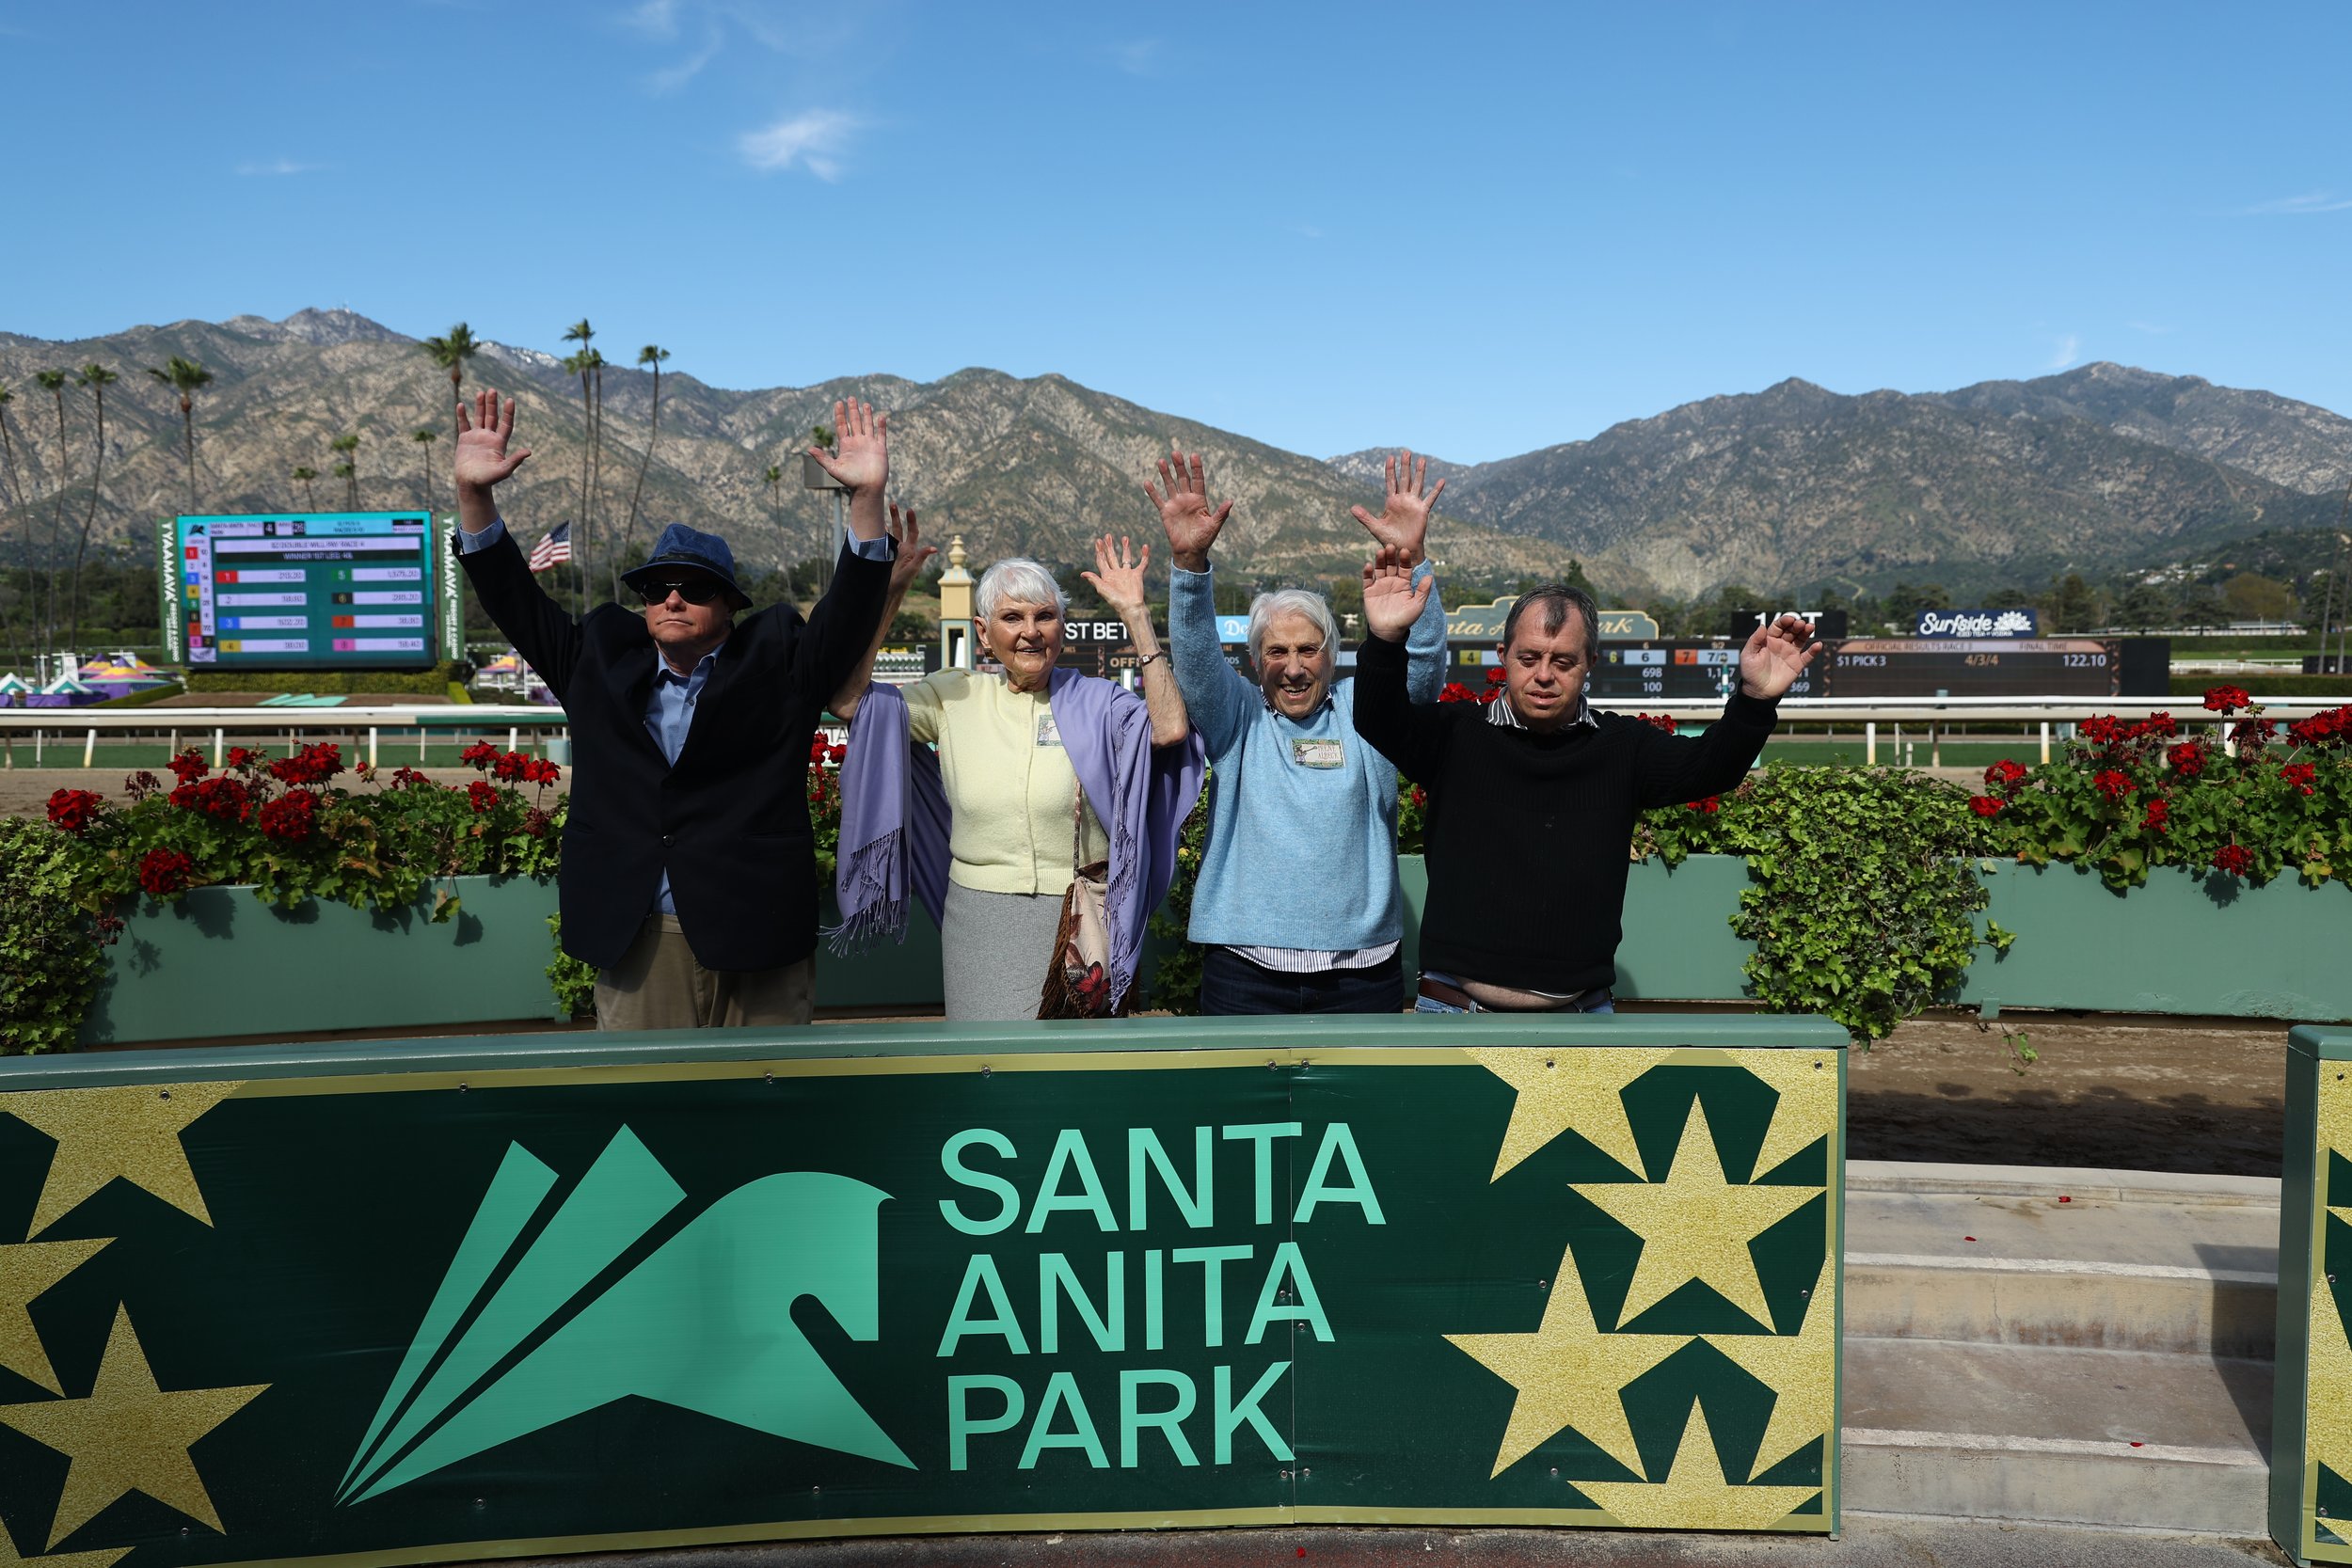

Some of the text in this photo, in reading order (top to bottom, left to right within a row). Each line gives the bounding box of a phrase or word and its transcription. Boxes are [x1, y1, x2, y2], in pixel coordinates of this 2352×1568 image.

[1919, 611, 1993, 635] Surfside
[1467, 652, 1474, 663] 4
[1609, 650, 1617, 663] 6
[1641, 653, 1650, 662] 6
[1683, 652, 1692, 663] 7
[1836, 656, 1887, 667] $1 PICK 3
[1964, 654, 1999, 667] 4/3/4
[2062, 655, 2107, 667] 122.10
[1642, 667, 1663, 678] 698
[1707, 667, 1736, 679] 1,17
[1643, 682, 1663, 692] 100
[1715, 682, 1736, 692] 49
[939, 1122, 1387, 1235] SANTA
[936, 1242, 1335, 1356] ANITA
[948, 1361, 1295, 1471] PARK
